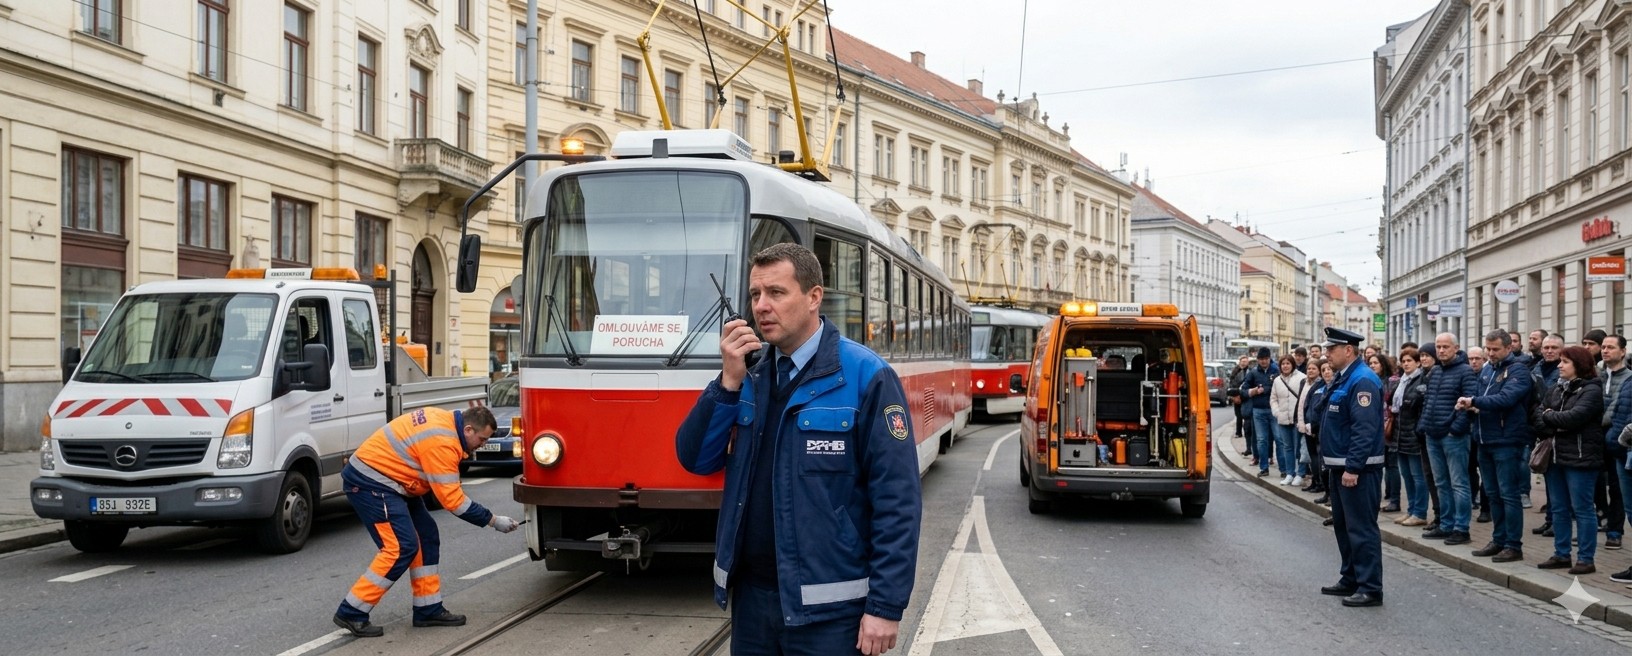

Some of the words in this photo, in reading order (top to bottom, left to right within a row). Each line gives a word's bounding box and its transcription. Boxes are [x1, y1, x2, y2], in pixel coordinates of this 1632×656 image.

[598, 321, 664, 333] OMLOUVÁME
[667, 323, 683, 335] SE,
[612, 337, 664, 347] PORUCHA
[125, 499, 151, 510] 932E
